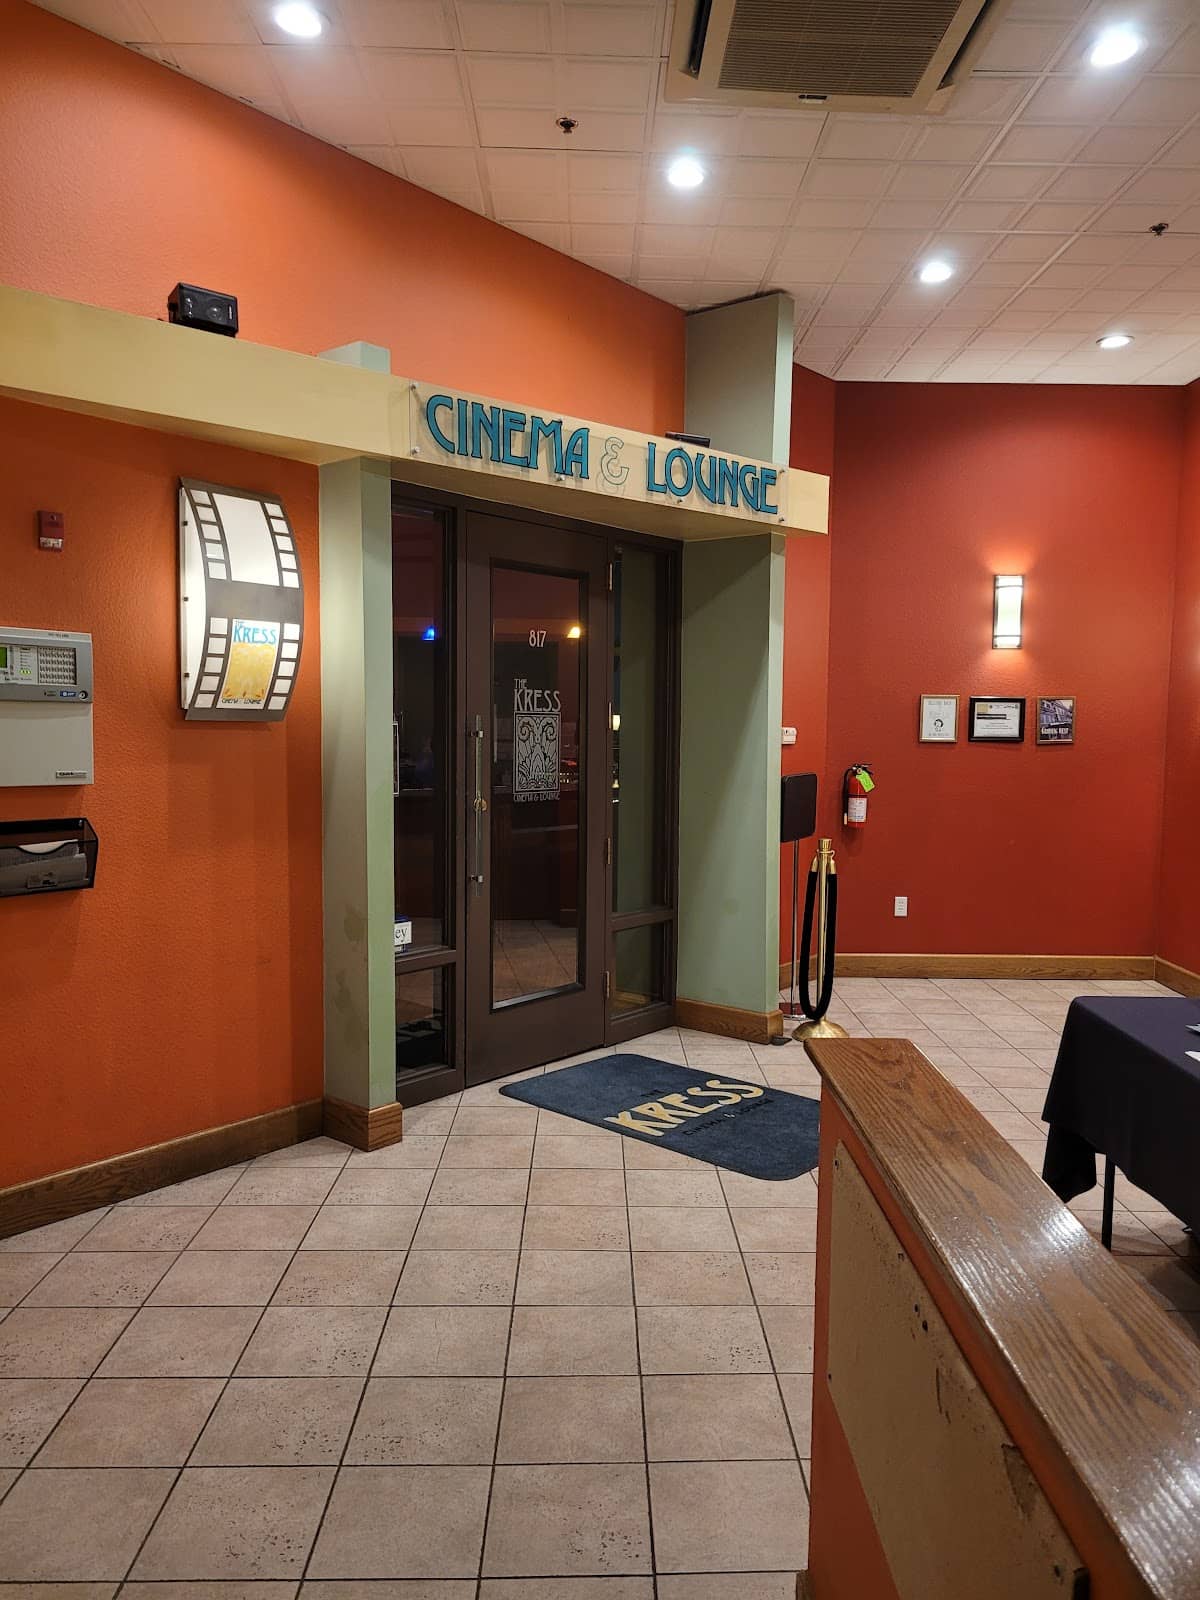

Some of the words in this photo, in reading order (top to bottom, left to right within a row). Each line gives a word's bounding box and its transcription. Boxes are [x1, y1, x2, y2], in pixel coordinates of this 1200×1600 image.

[426, 394, 590, 480] CINEMA
[600, 437, 630, 486] &
[647, 441, 778, 515] LOUNGE
[233, 623, 277, 645] KRESS
[528, 630, 547, 648] 817
[513, 678, 528, 689] THE
[513, 689, 561, 712] KRESS
[603, 1079, 765, 1137] KRESS
